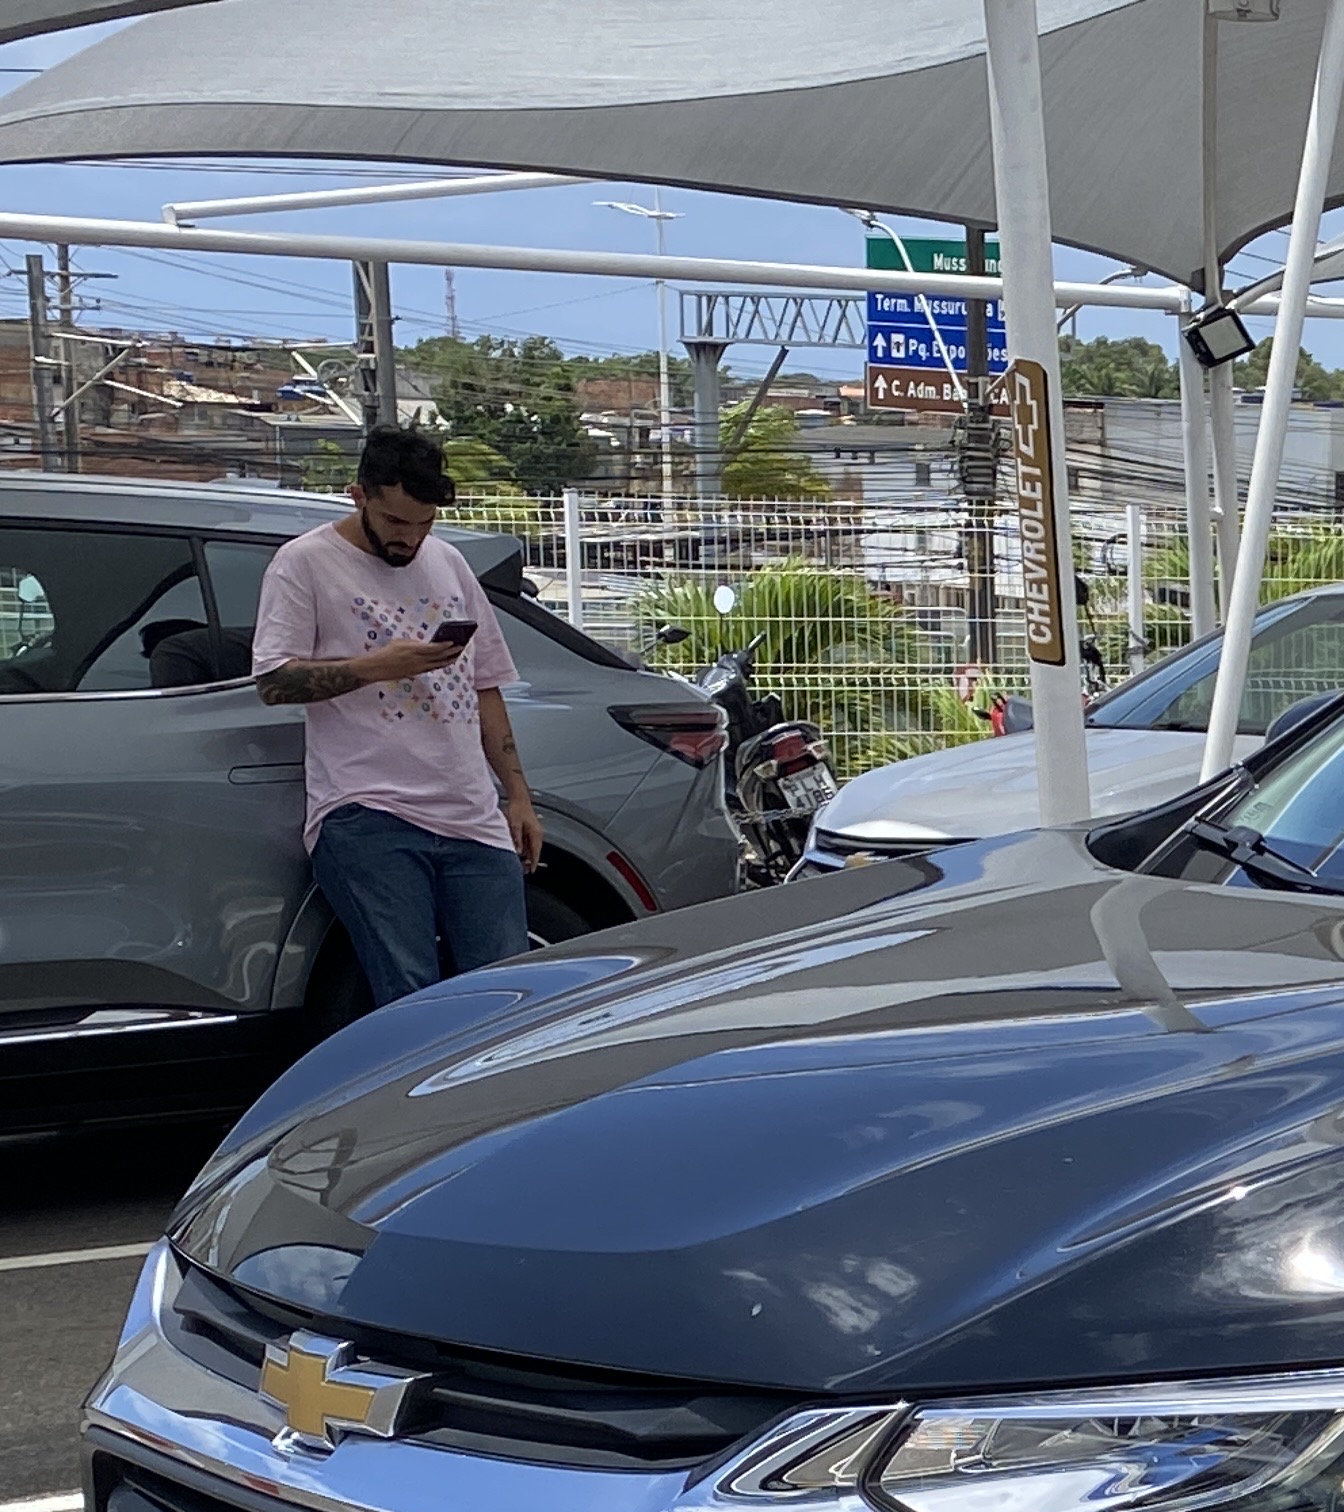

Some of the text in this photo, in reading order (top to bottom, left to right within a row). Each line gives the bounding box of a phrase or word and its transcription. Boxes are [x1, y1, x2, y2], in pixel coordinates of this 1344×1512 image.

[875, 293, 911, 312] Term.
[908, 338, 930, 361] Pq.
[891, 379, 904, 396] C.
[907, 381, 940, 399] Adm.
[1016, 458, 1051, 644] CHEVROLET
